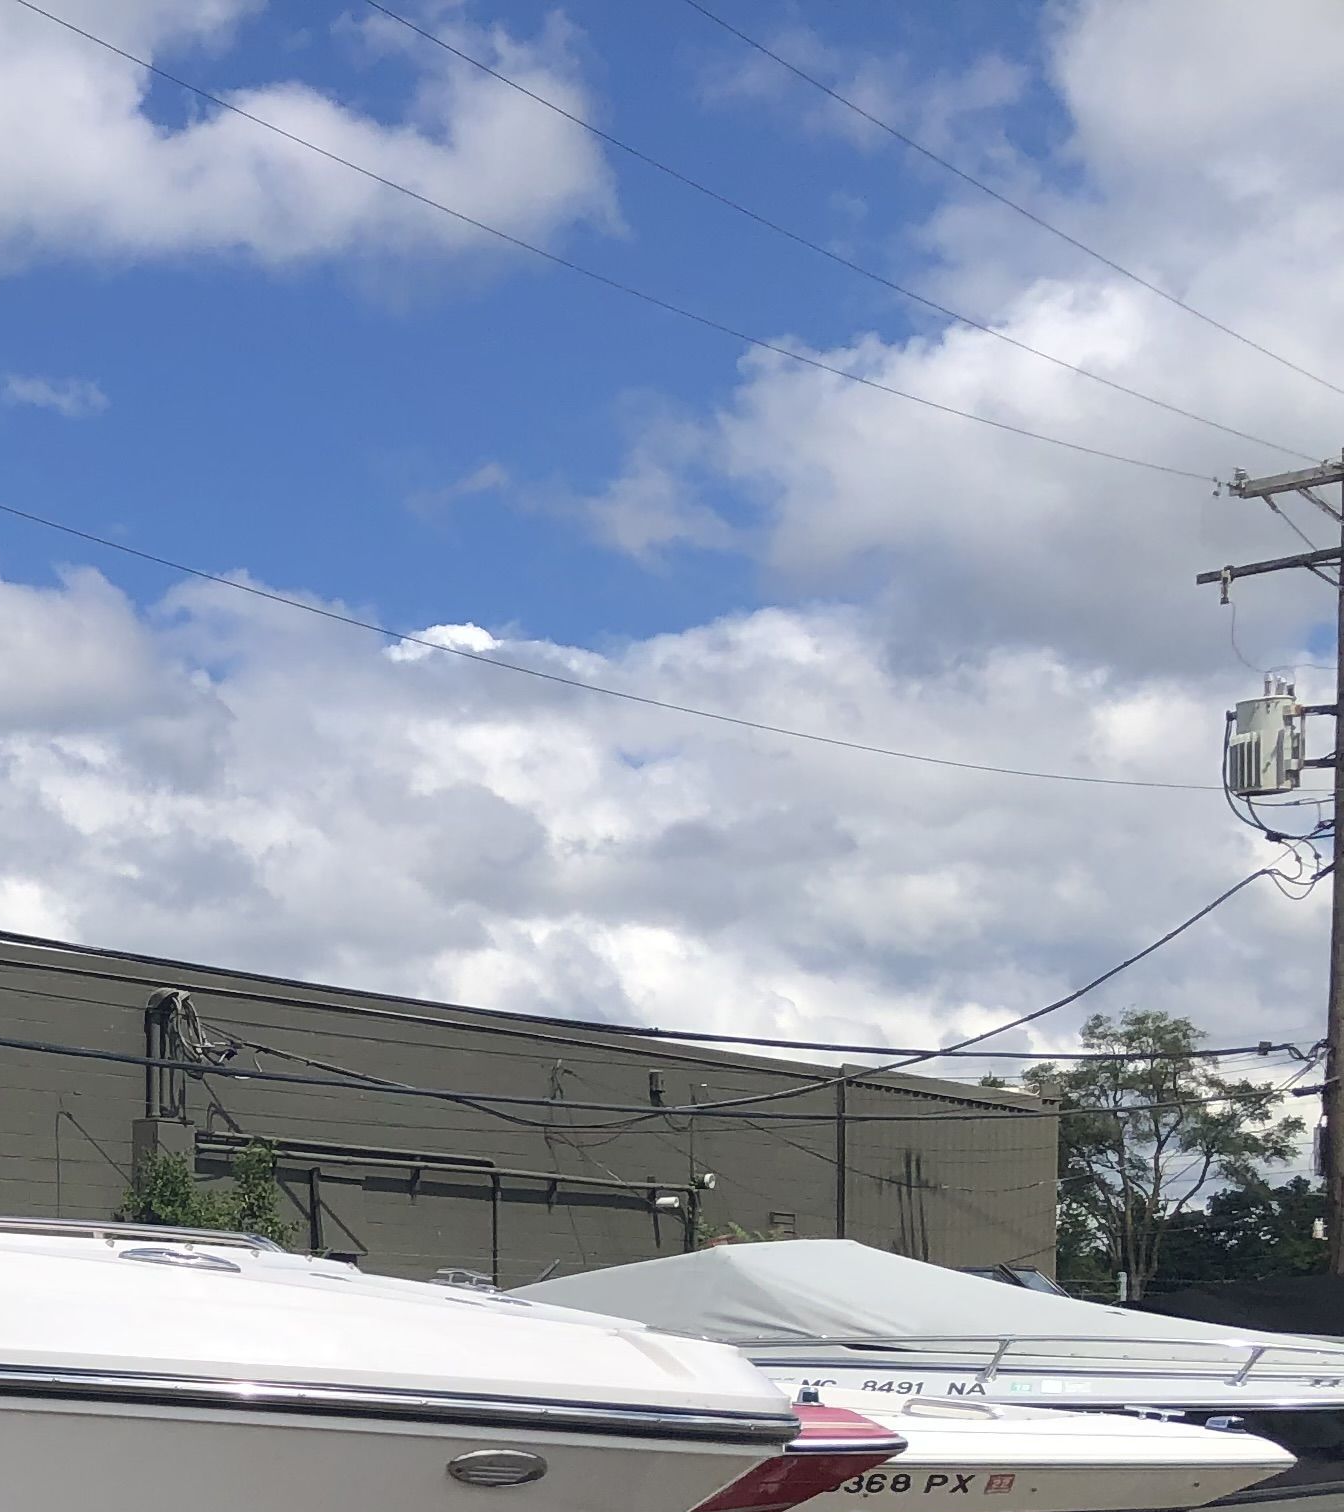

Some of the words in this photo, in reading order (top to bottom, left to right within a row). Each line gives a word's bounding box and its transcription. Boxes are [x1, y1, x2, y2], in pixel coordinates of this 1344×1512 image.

[861, 1380, 925, 1395] 8491
[947, 1382, 986, 1395] NA
[821, 1473, 911, 1494] 368
[923, 1474, 976, 1493] PX
